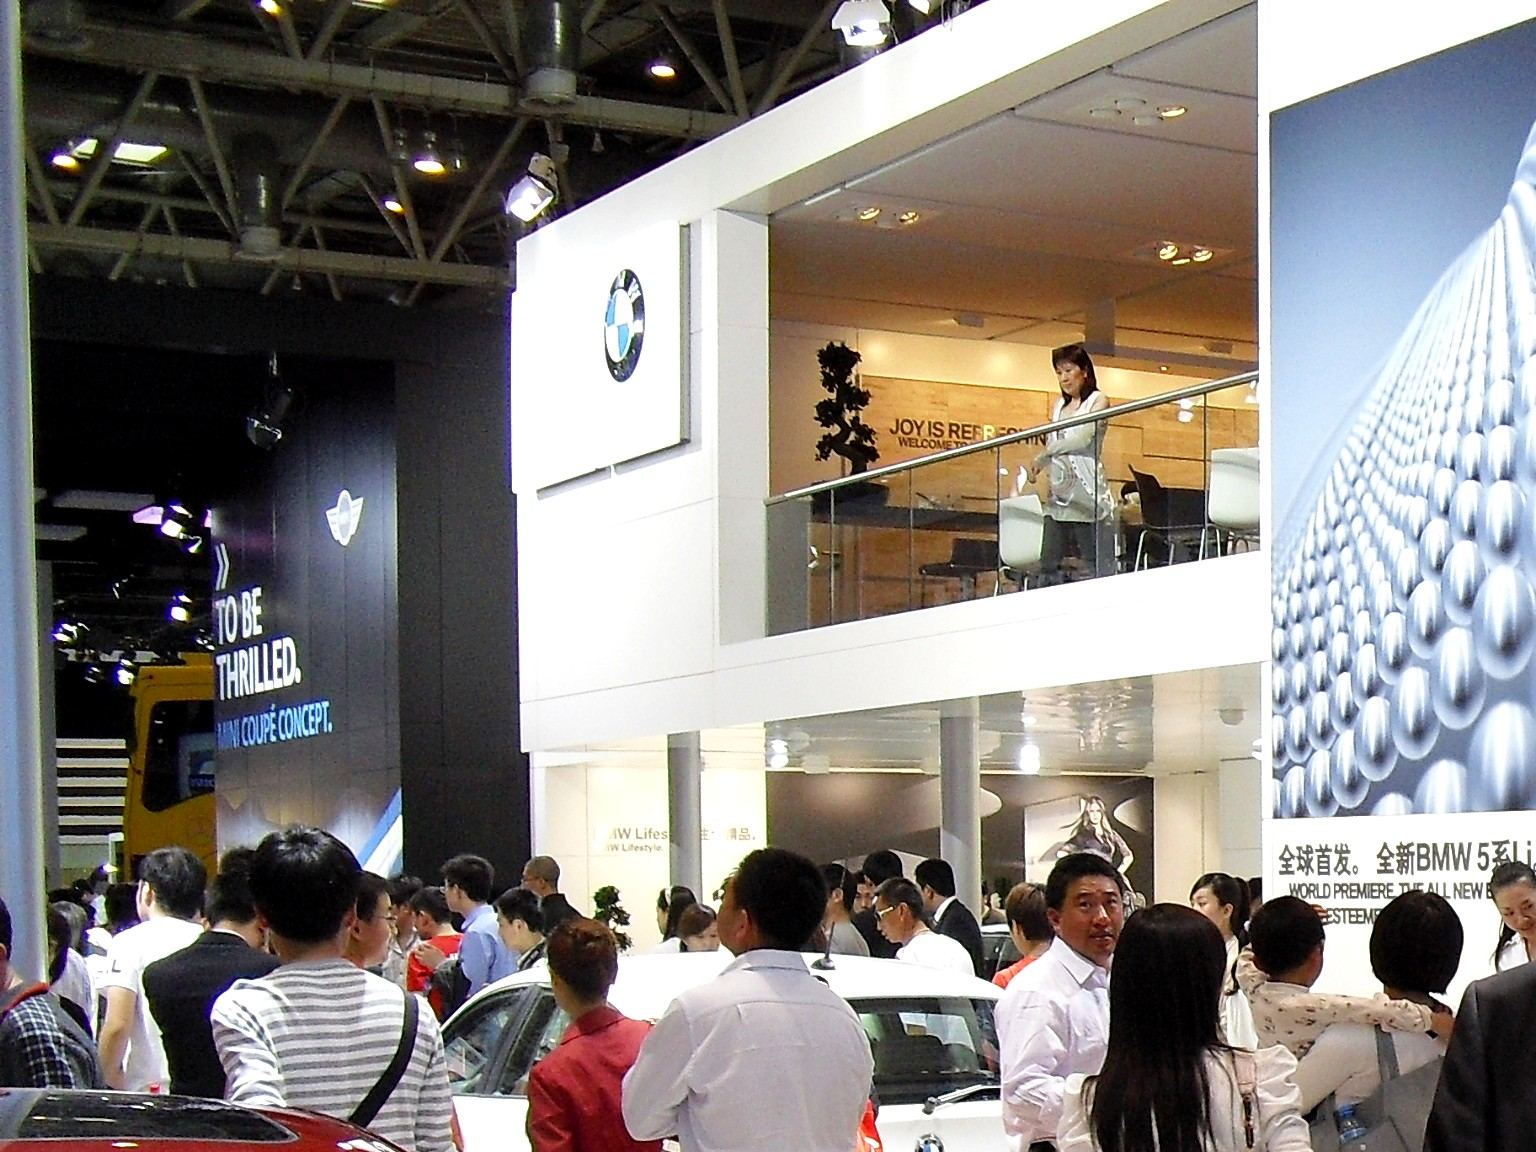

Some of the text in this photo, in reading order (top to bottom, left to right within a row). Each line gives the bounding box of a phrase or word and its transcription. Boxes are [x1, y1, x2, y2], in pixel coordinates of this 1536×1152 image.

[890, 419, 924, 436] JOY
[928, 420, 944, 438] IS
[215, 587, 263, 645] TO BE
[215, 636, 302, 700] THRILLED.
[241, 703, 277, 747] COUPÉ
[278, 700, 333, 741] CONCEPT.
[1279, 844, 1359, 876] 全球首发。
[1377, 841, 1472, 876] 全新BMW
[1289, 883, 1331, 899] WORLD
[1453, 882, 1483, 900] NEW
